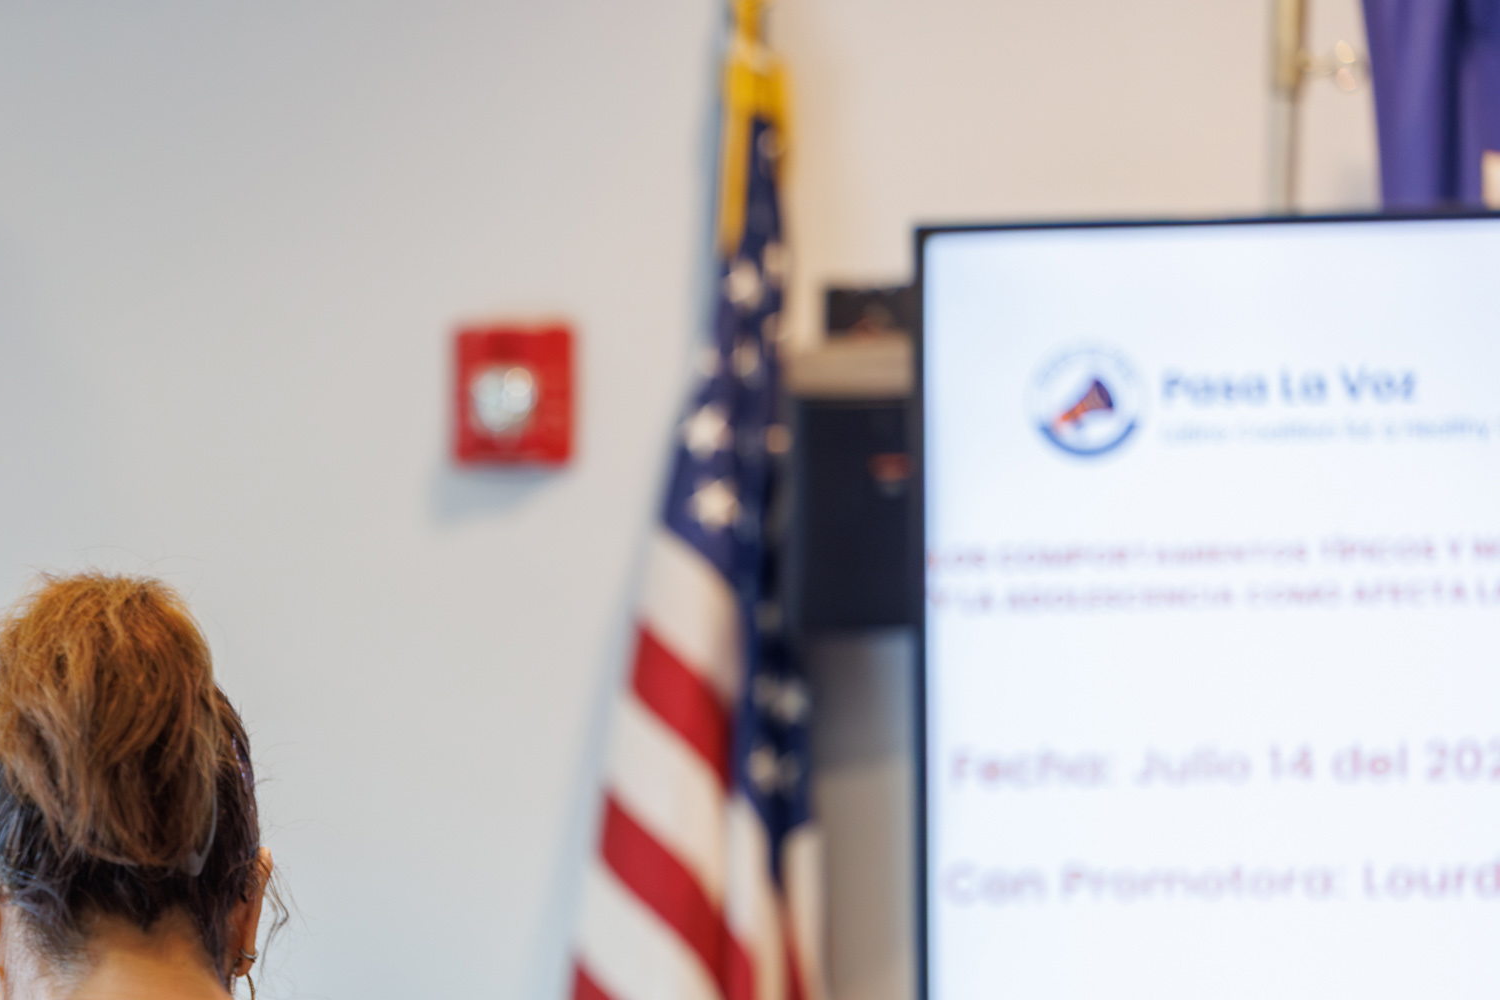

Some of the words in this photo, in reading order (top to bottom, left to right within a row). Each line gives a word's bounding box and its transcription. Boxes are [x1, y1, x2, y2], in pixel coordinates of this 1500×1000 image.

[1160, 369, 1269, 405] Pasa
[1279, 367, 1329, 403] La
[1337, 364, 1418, 402] Voz
[952, 746, 1115, 788] Fecha:
[1133, 744, 1253, 785] Julio
[1267, 742, 1316, 781] 14
[1331, 741, 1409, 783] del
[1059, 862, 1348, 902] Promotora:
